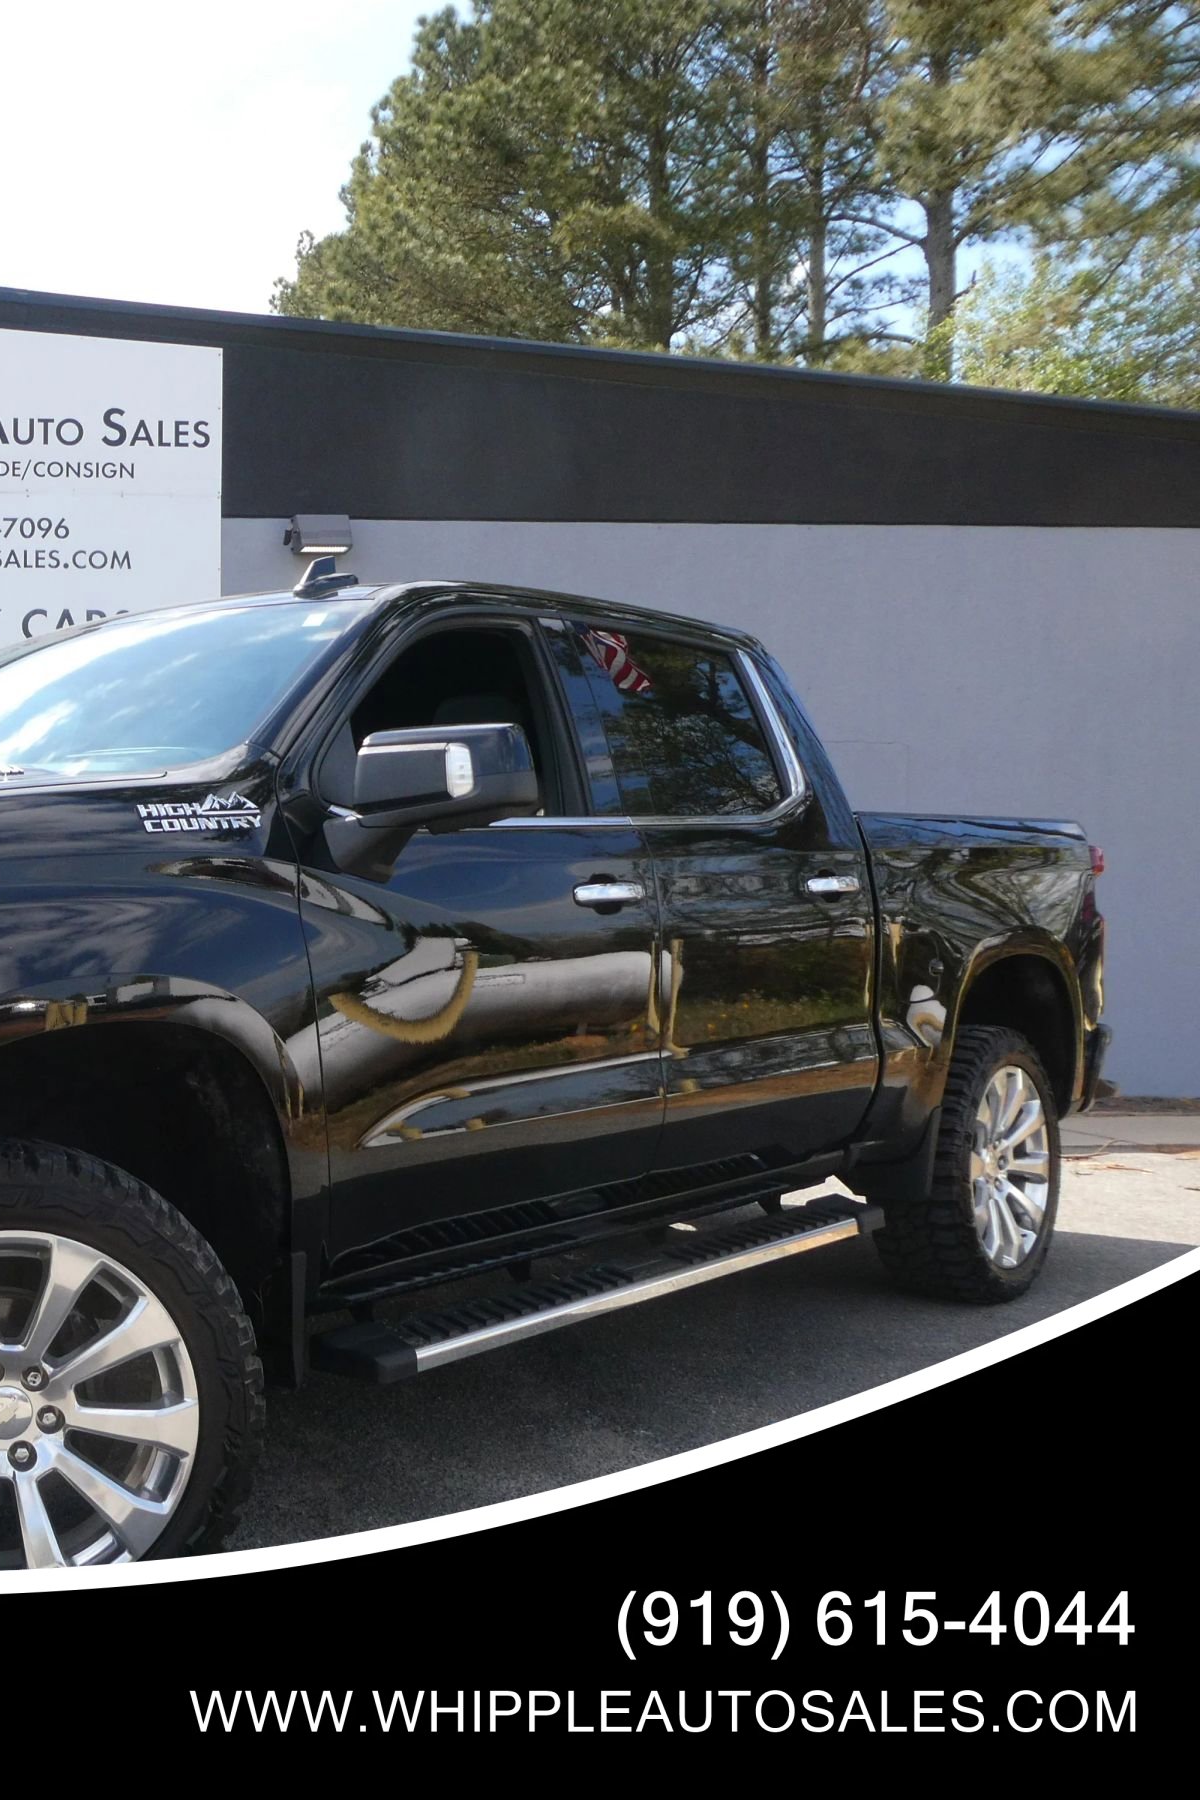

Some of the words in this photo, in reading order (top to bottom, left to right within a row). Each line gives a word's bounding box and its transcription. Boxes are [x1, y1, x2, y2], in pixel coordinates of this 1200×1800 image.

[101, 407, 211, 449] SALES
[21, 608, 130, 639] CA
[136, 802, 201, 818] HIGH
[143, 815, 262, 833] COUNTRY
